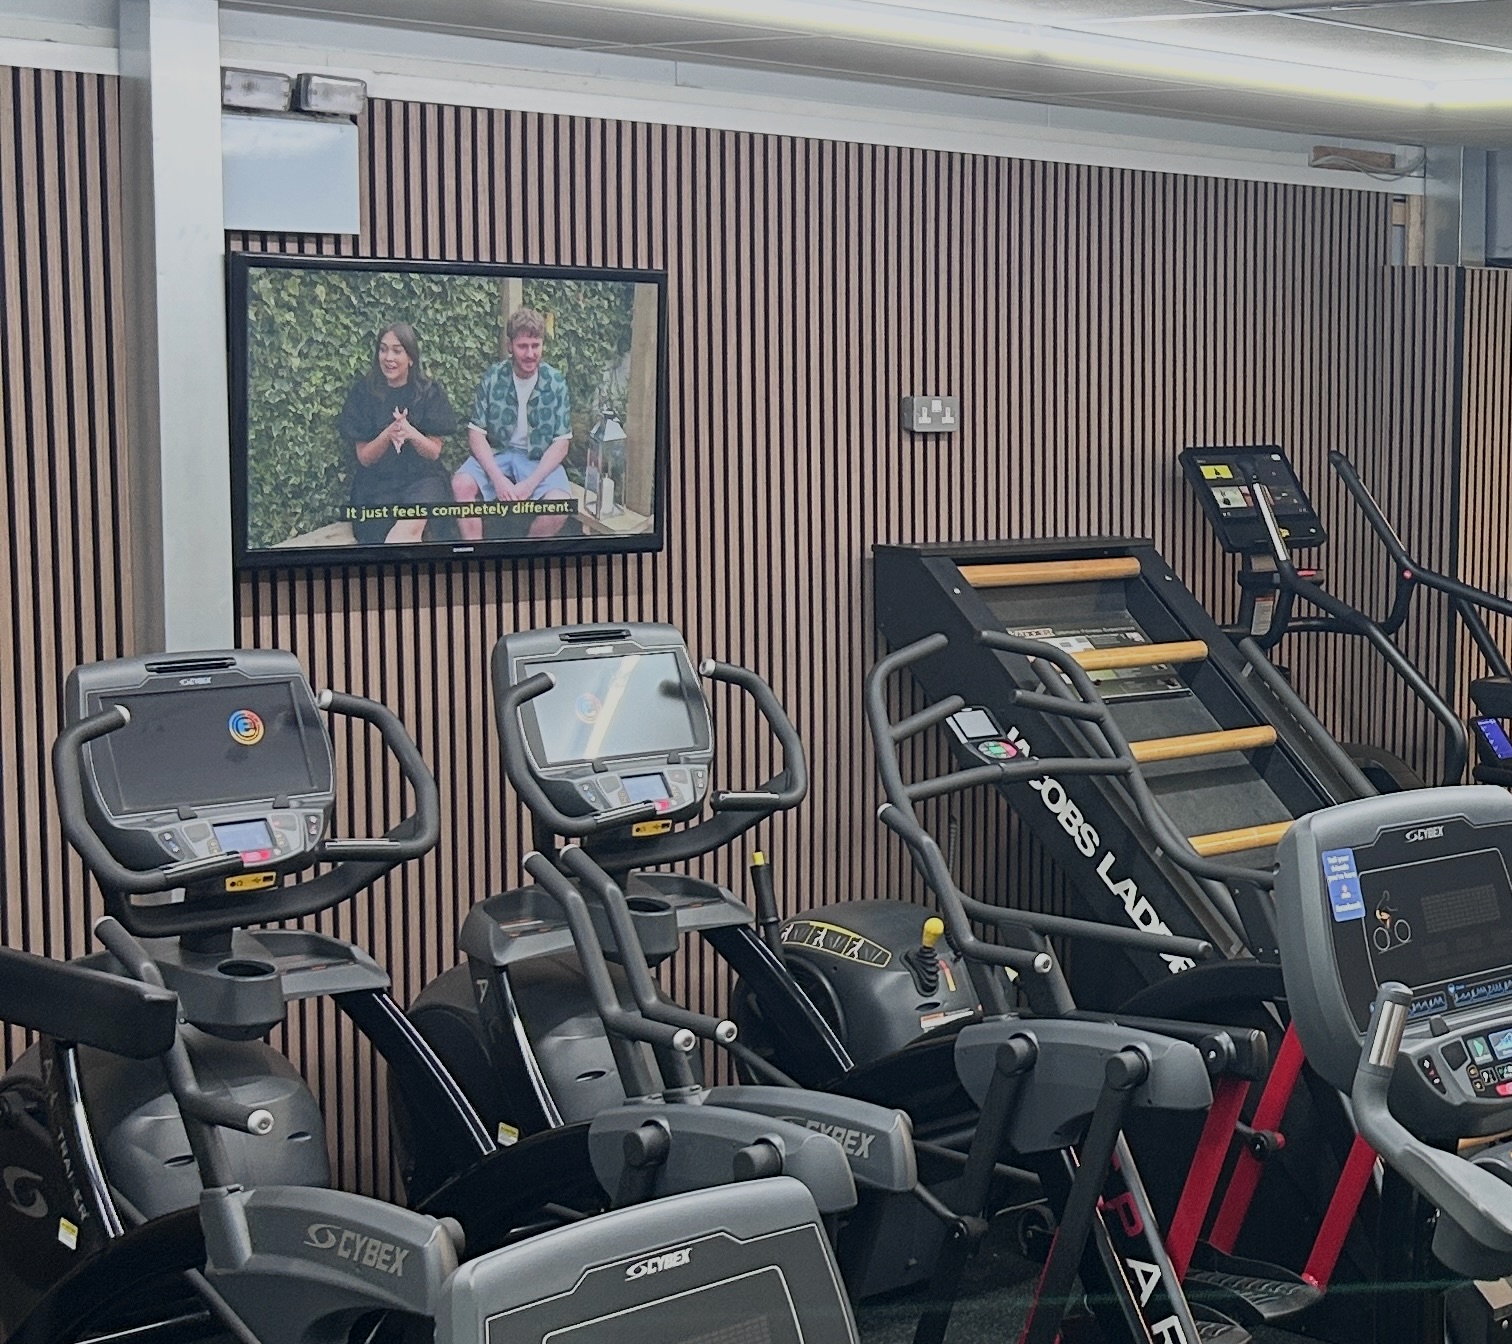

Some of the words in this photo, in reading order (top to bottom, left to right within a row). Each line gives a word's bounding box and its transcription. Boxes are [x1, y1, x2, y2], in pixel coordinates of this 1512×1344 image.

[346, 506, 357, 520] It
[360, 506, 389, 522] just
[392, 505, 428, 519] feels
[431, 501, 508, 518] completely
[511, 501, 575, 515] different.
[338, 1230, 410, 1278] CYBEX
[647, 1247, 693, 1275] CYBEX
